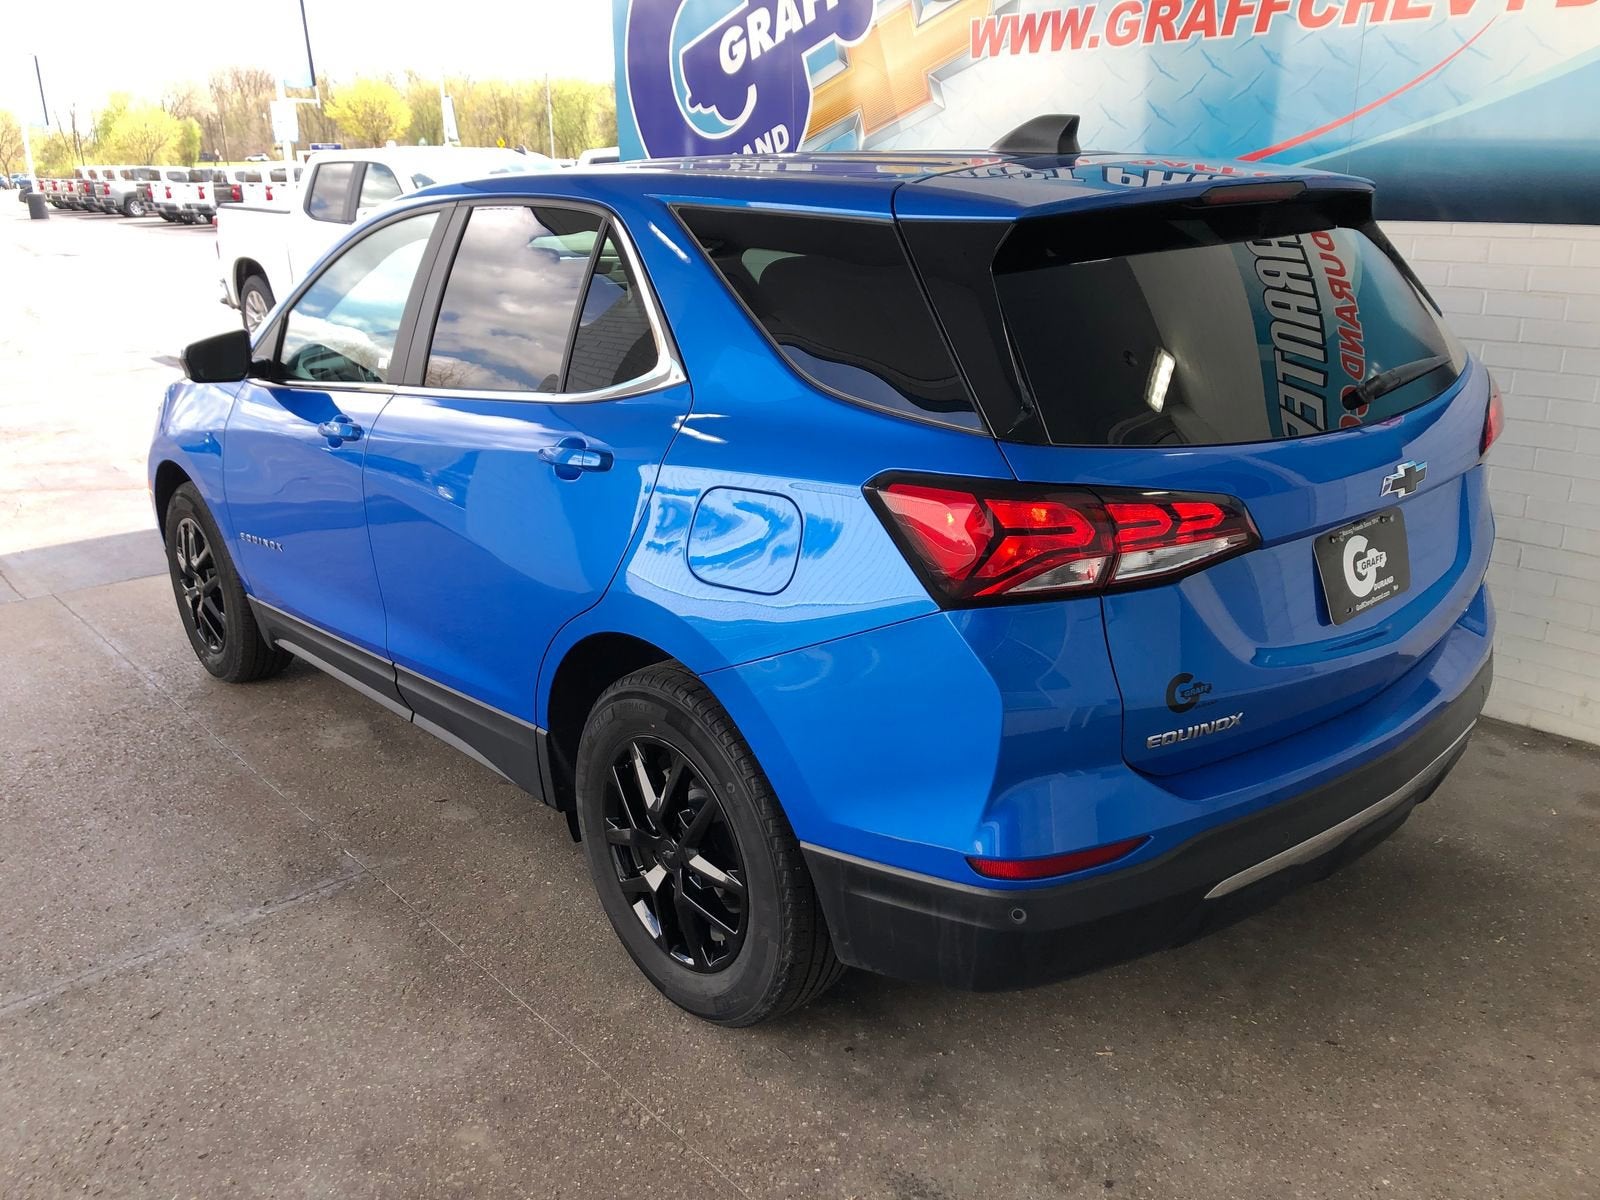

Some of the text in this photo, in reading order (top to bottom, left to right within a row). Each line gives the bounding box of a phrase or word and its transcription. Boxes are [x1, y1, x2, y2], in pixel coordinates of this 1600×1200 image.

[719, 0, 839, 75] GRAF
[240, 532, 284, 552] EQUINOX
[1361, 553, 1384, 570] GRAFF
[1146, 712, 1244, 749] EQUINOX
